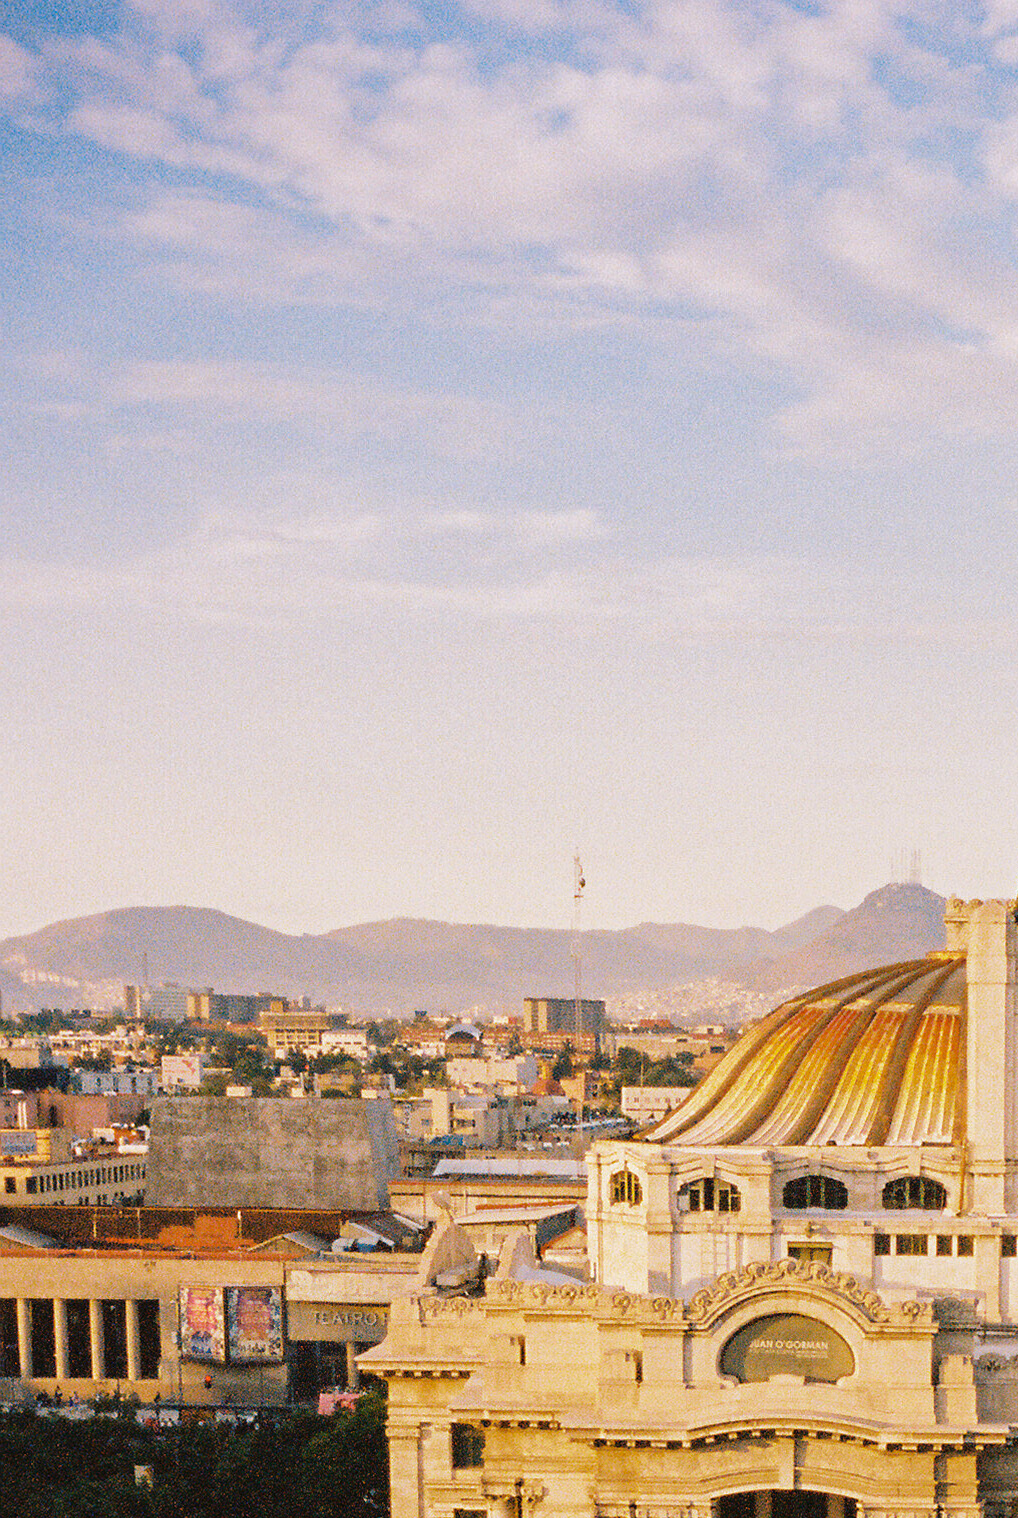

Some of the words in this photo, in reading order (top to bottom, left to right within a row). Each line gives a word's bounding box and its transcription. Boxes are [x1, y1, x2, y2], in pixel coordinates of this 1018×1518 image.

[314, 1311, 378, 1326] TEATRO
[749, 1339, 773, 1348] JUAN
[775, 1340, 829, 1350] O'GORMAN
